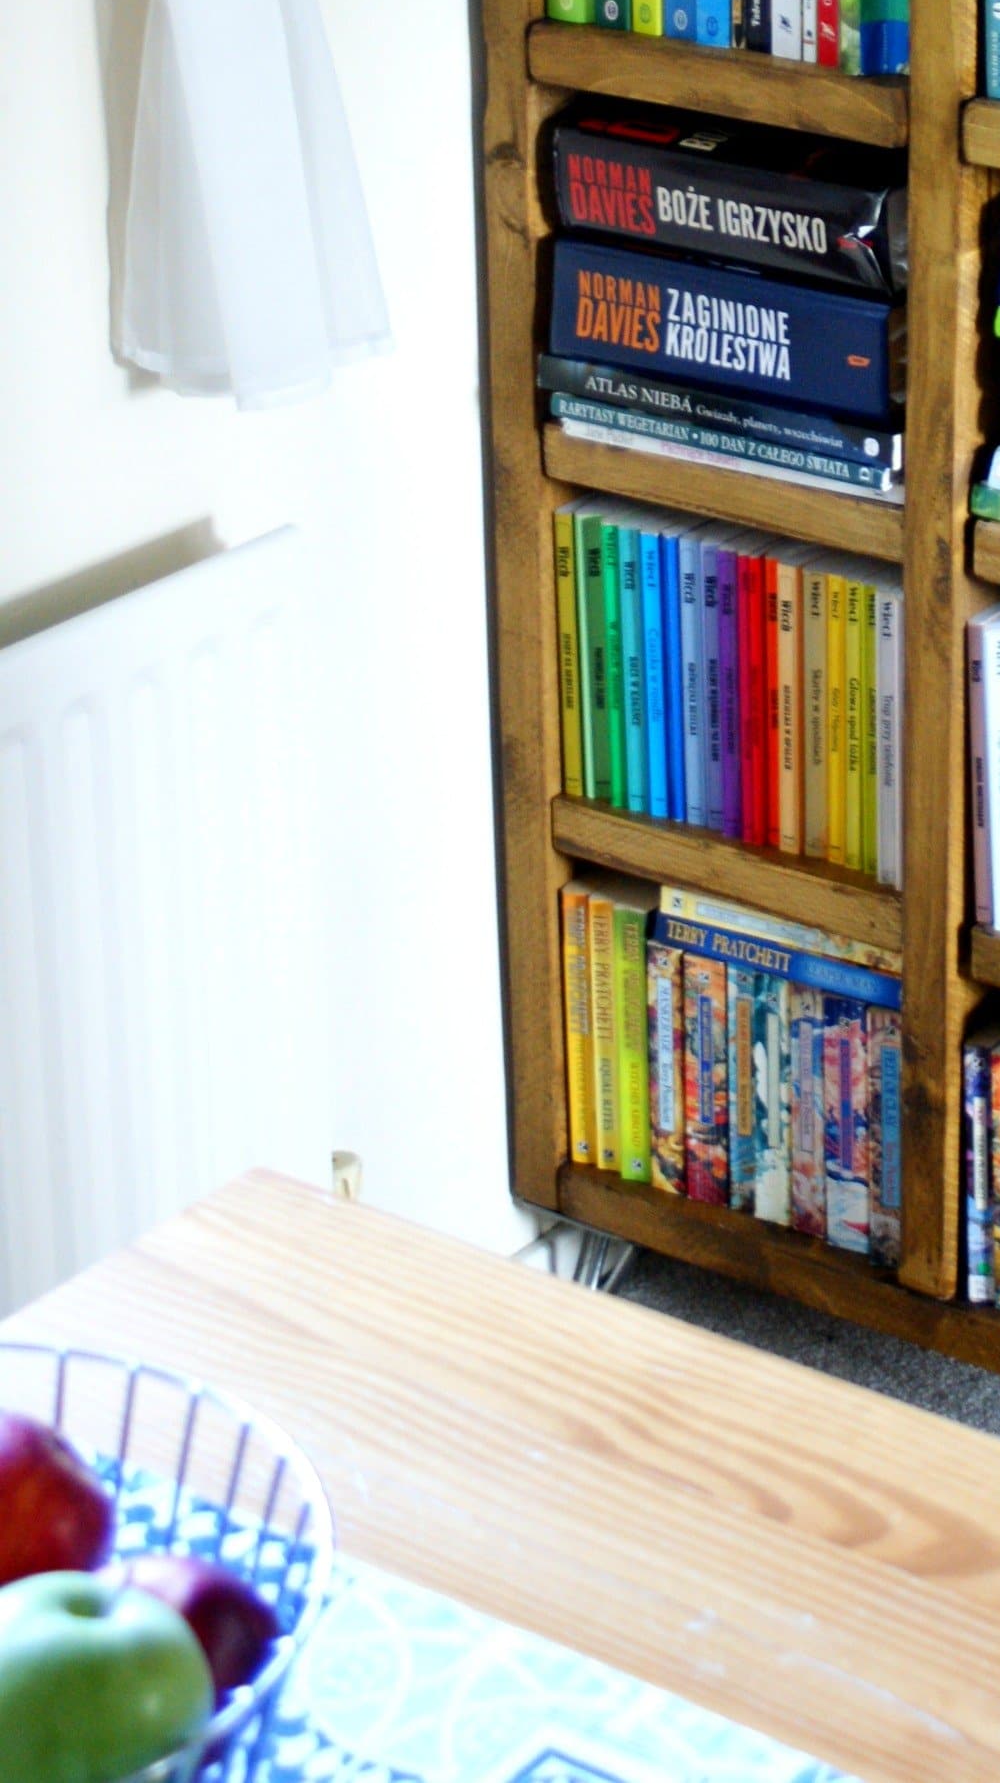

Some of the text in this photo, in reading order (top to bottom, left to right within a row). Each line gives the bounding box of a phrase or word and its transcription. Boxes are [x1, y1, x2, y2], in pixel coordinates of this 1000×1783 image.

[567, 154, 651, 196] NORMAN
[569, 182, 655, 235] DAVIES
[657, 186, 827, 254] BOŻE IGRZYSKO
[579, 270, 661, 312] NORMAN
[576, 297, 661, 353] DAVIES
[667, 288, 791, 345] ZAGINIONE
[666, 323, 791, 380] KRÓLESTWA
[585, 376, 637, 402] ATLAS
[557, 546, 571, 577] Wiech
[624, 561, 637, 590] Wiech
[684, 573, 696, 604] Wiech
[705, 575, 717, 607] Wiech
[667, 919, 792, 973] TERRY PRATCHETT
[593, 914, 613, 1043] TERRY PRATCHETT
